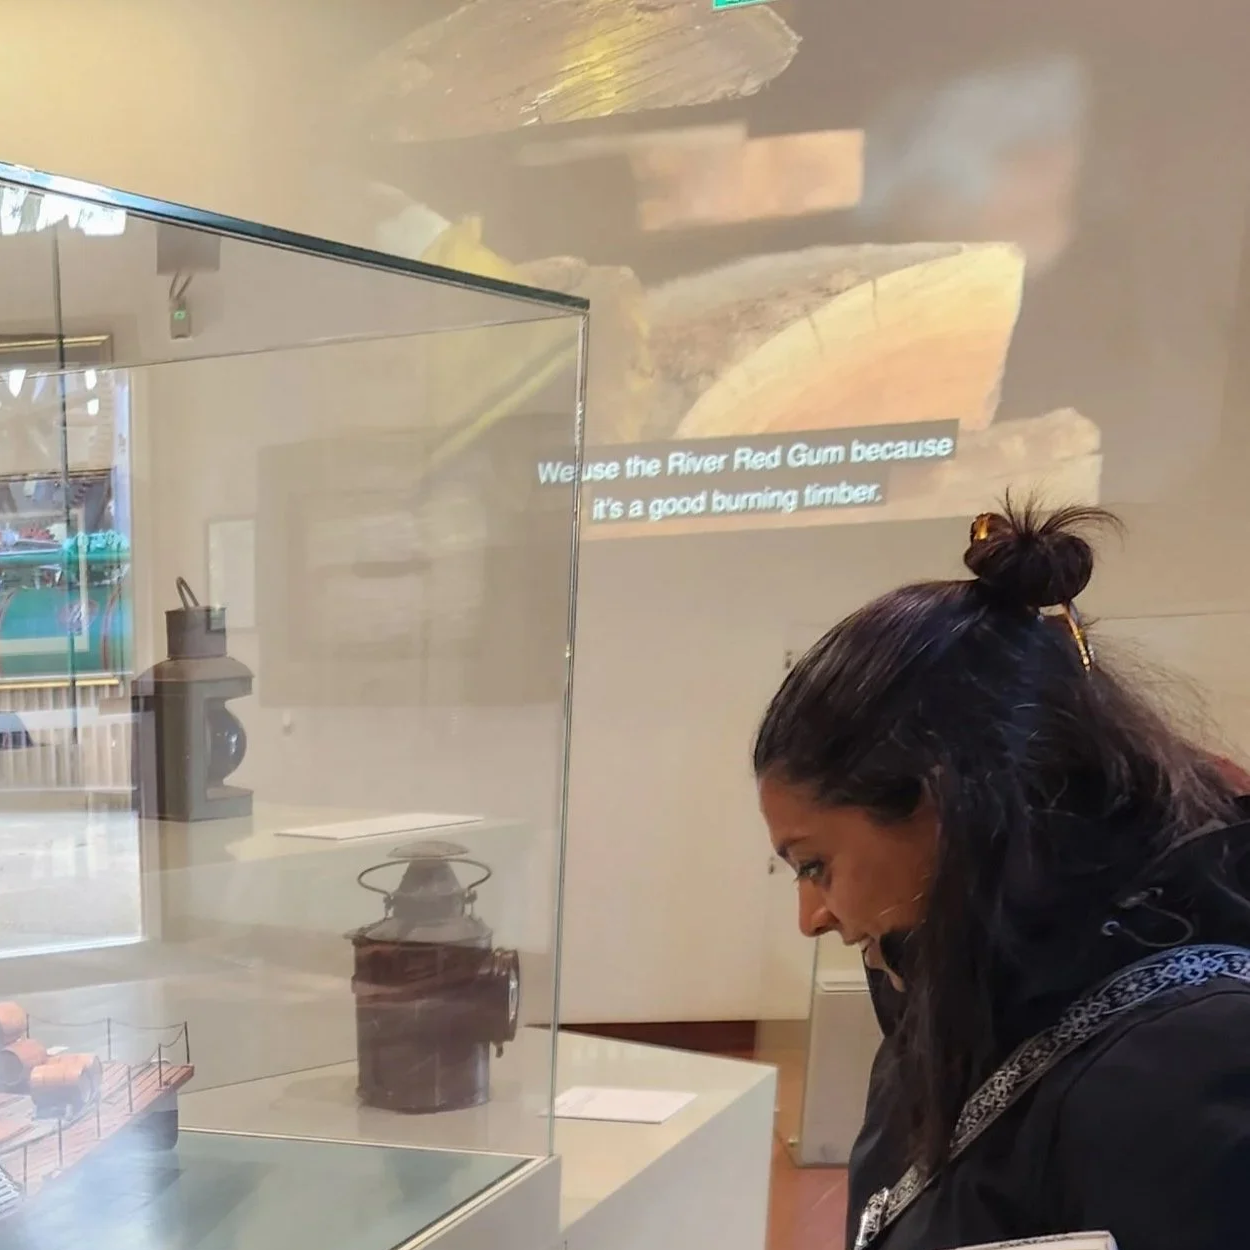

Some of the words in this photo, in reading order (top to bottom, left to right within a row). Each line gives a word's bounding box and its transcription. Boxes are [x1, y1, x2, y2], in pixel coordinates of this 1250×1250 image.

[537, 460, 578, 484] We
[580, 461, 620, 482] use
[625, 454, 662, 478] the
[667, 450, 730, 476] River
[733, 445, 781, 472] Red
[787, 442, 846, 468] Gum
[850, 436, 953, 463] because
[592, 496, 624, 521] it's
[628, 500, 645, 519] a
[649, 490, 707, 521] good
[712, 486, 799, 515] burning
[804, 481, 883, 506] timber.
